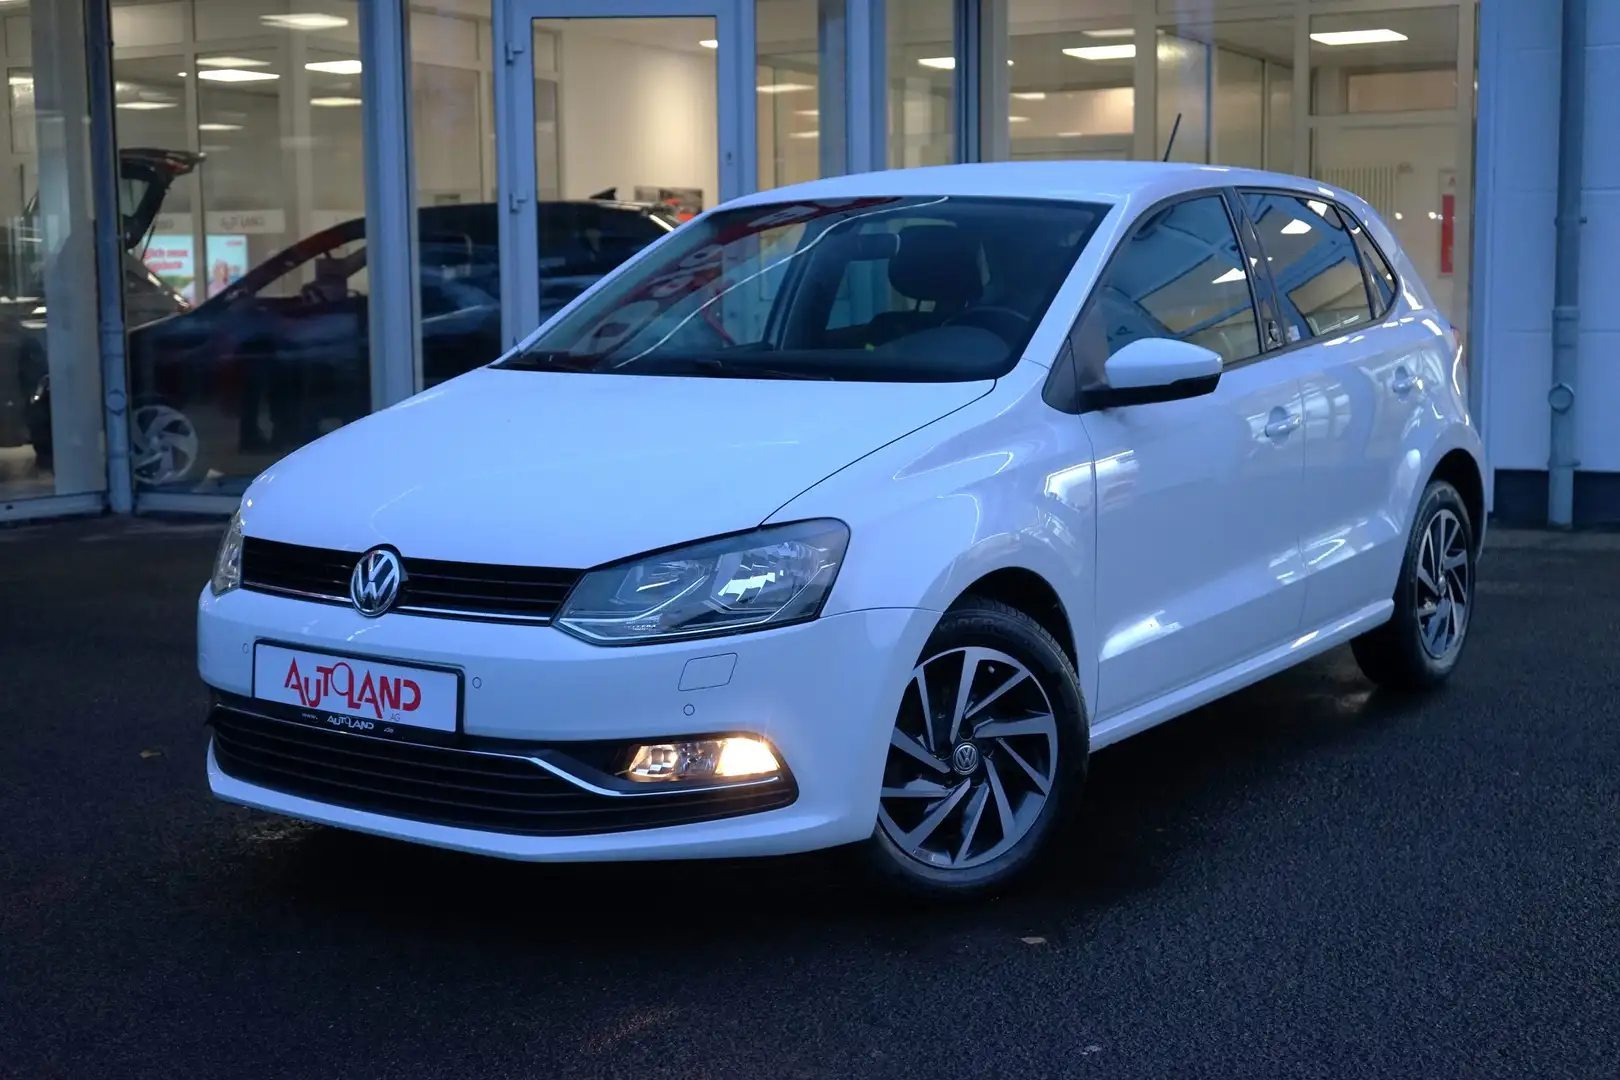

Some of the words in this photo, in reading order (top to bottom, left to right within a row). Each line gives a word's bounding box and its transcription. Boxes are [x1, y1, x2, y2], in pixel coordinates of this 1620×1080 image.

[353, 551, 398, 613] VW
[284, 657, 421, 719] AUTOLAND
[326, 714, 375, 730] AUTOLAND
[389, 712, 401, 722] AG
[955, 745, 977, 770] VW
